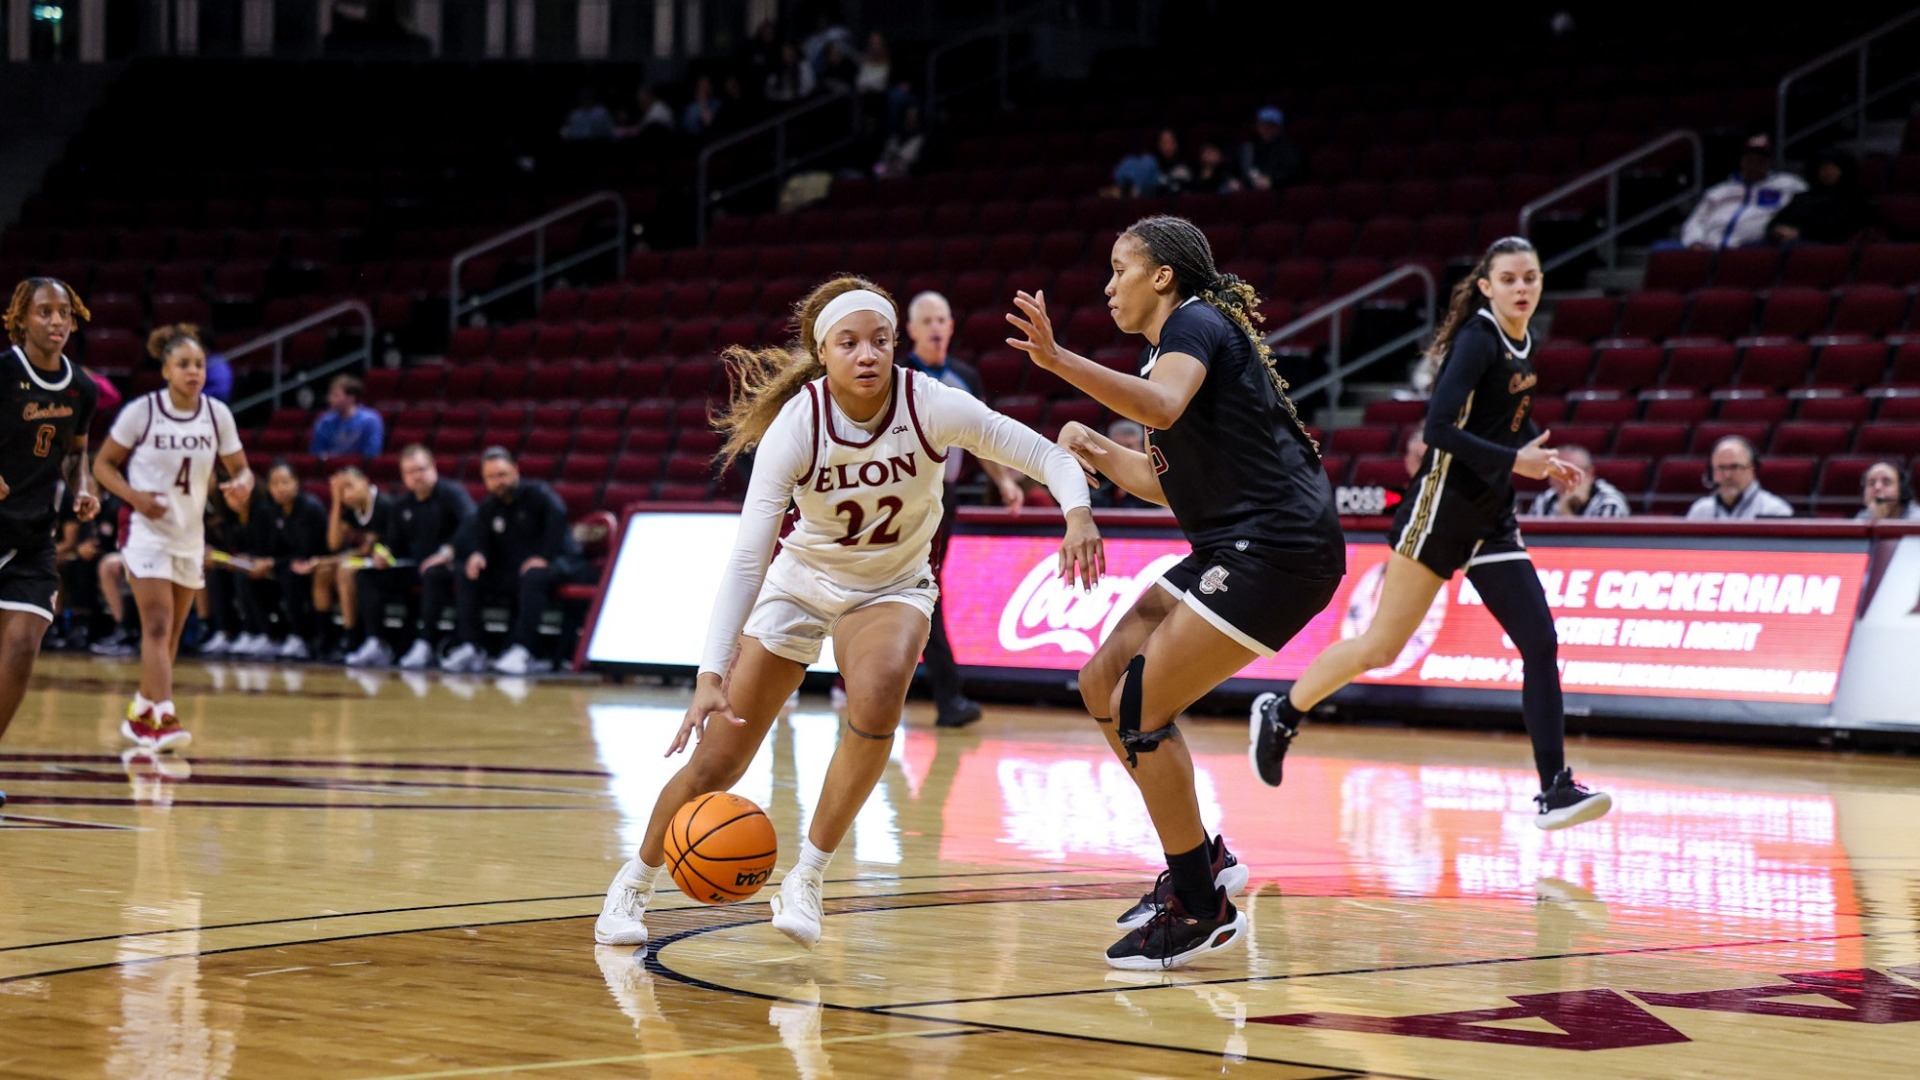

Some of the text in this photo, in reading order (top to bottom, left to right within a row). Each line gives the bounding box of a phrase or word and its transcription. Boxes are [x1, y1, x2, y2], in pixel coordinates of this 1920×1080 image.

[33, 423, 56, 458] 0
[154, 434, 212, 450] ELON
[174, 456, 192, 495] 4
[814, 452, 917, 493] ELON
[835, 495, 903, 546] 22
[1594, 570, 1842, 615] COCKERHAM
[1554, 617, 1763, 652] STATE FARM AGENT
